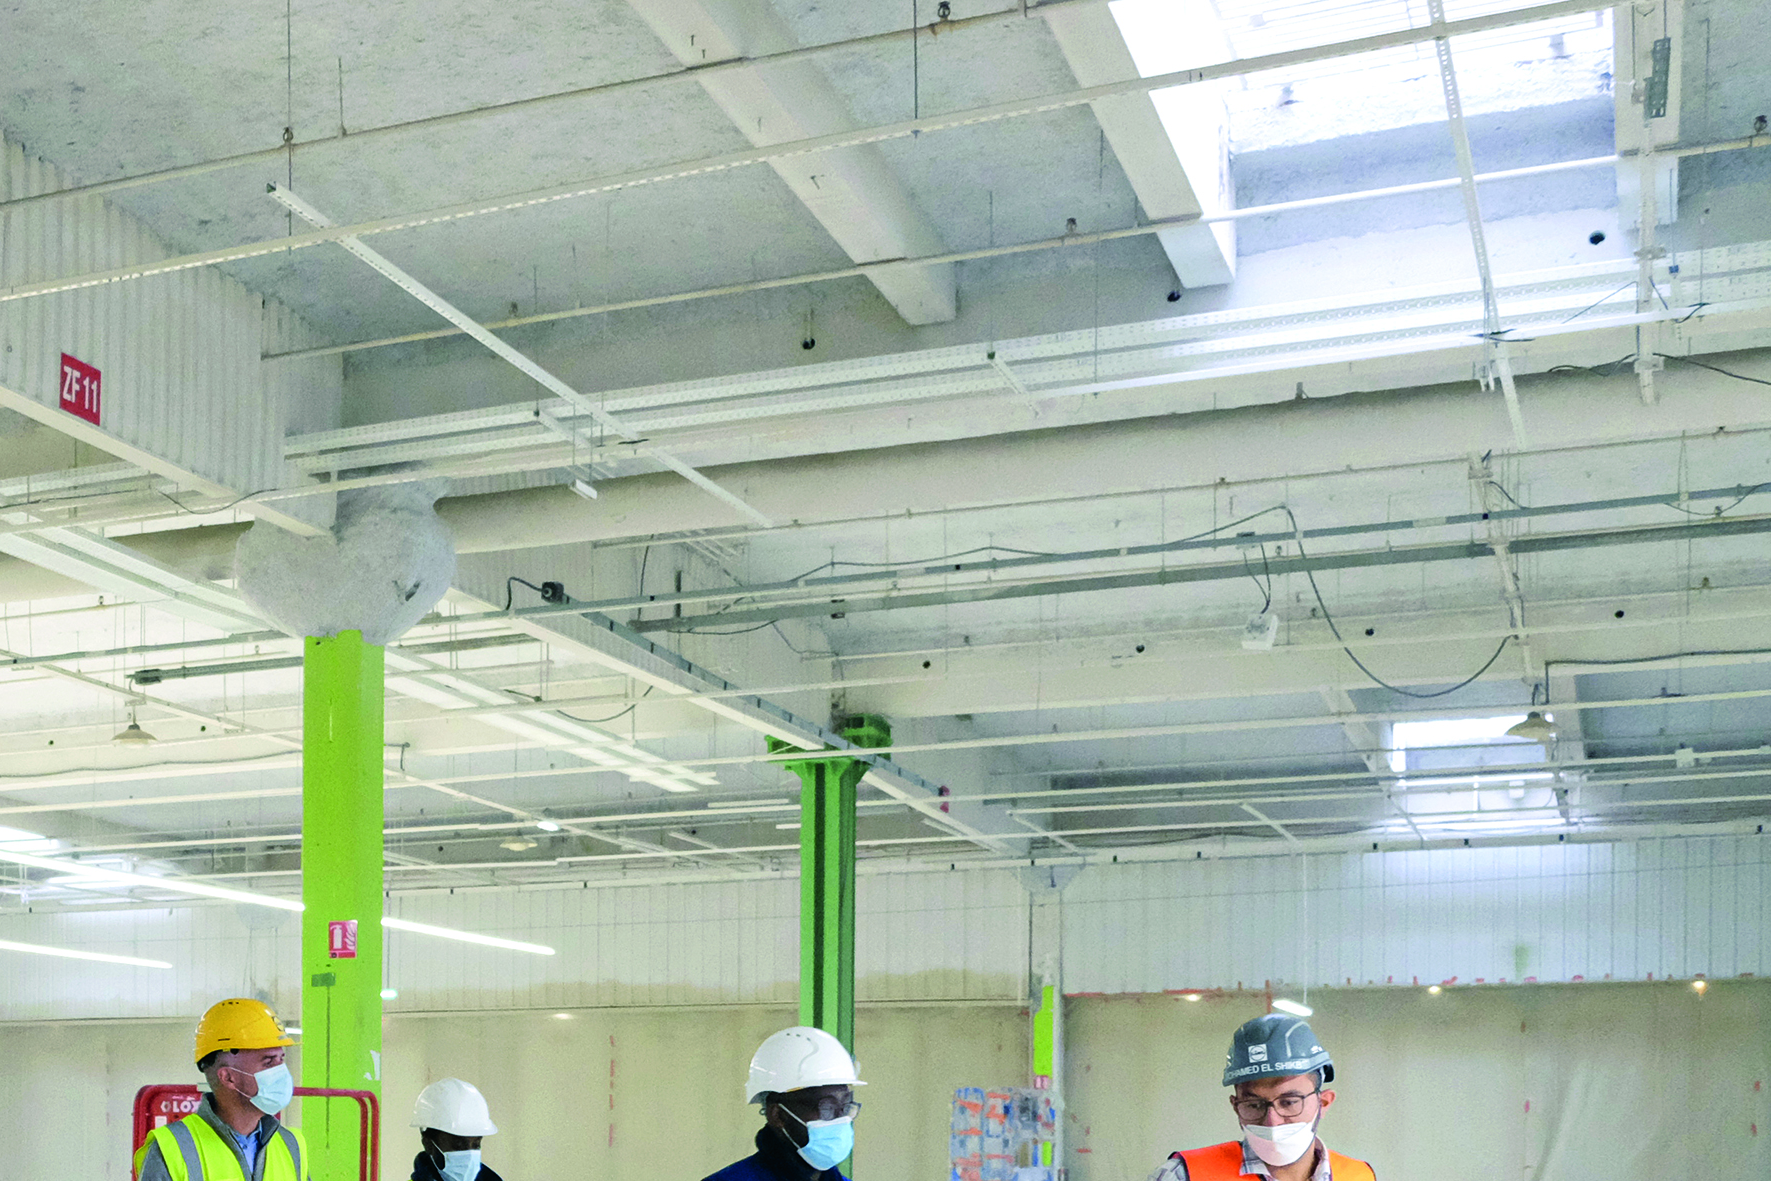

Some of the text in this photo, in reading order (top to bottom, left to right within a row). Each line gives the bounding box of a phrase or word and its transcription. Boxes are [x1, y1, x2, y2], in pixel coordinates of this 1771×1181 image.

[62, 365, 98, 413] ZF 11
[1225, 1066, 1260, 1080] OHAMED
[1261, 1063, 1274, 1072] EL
